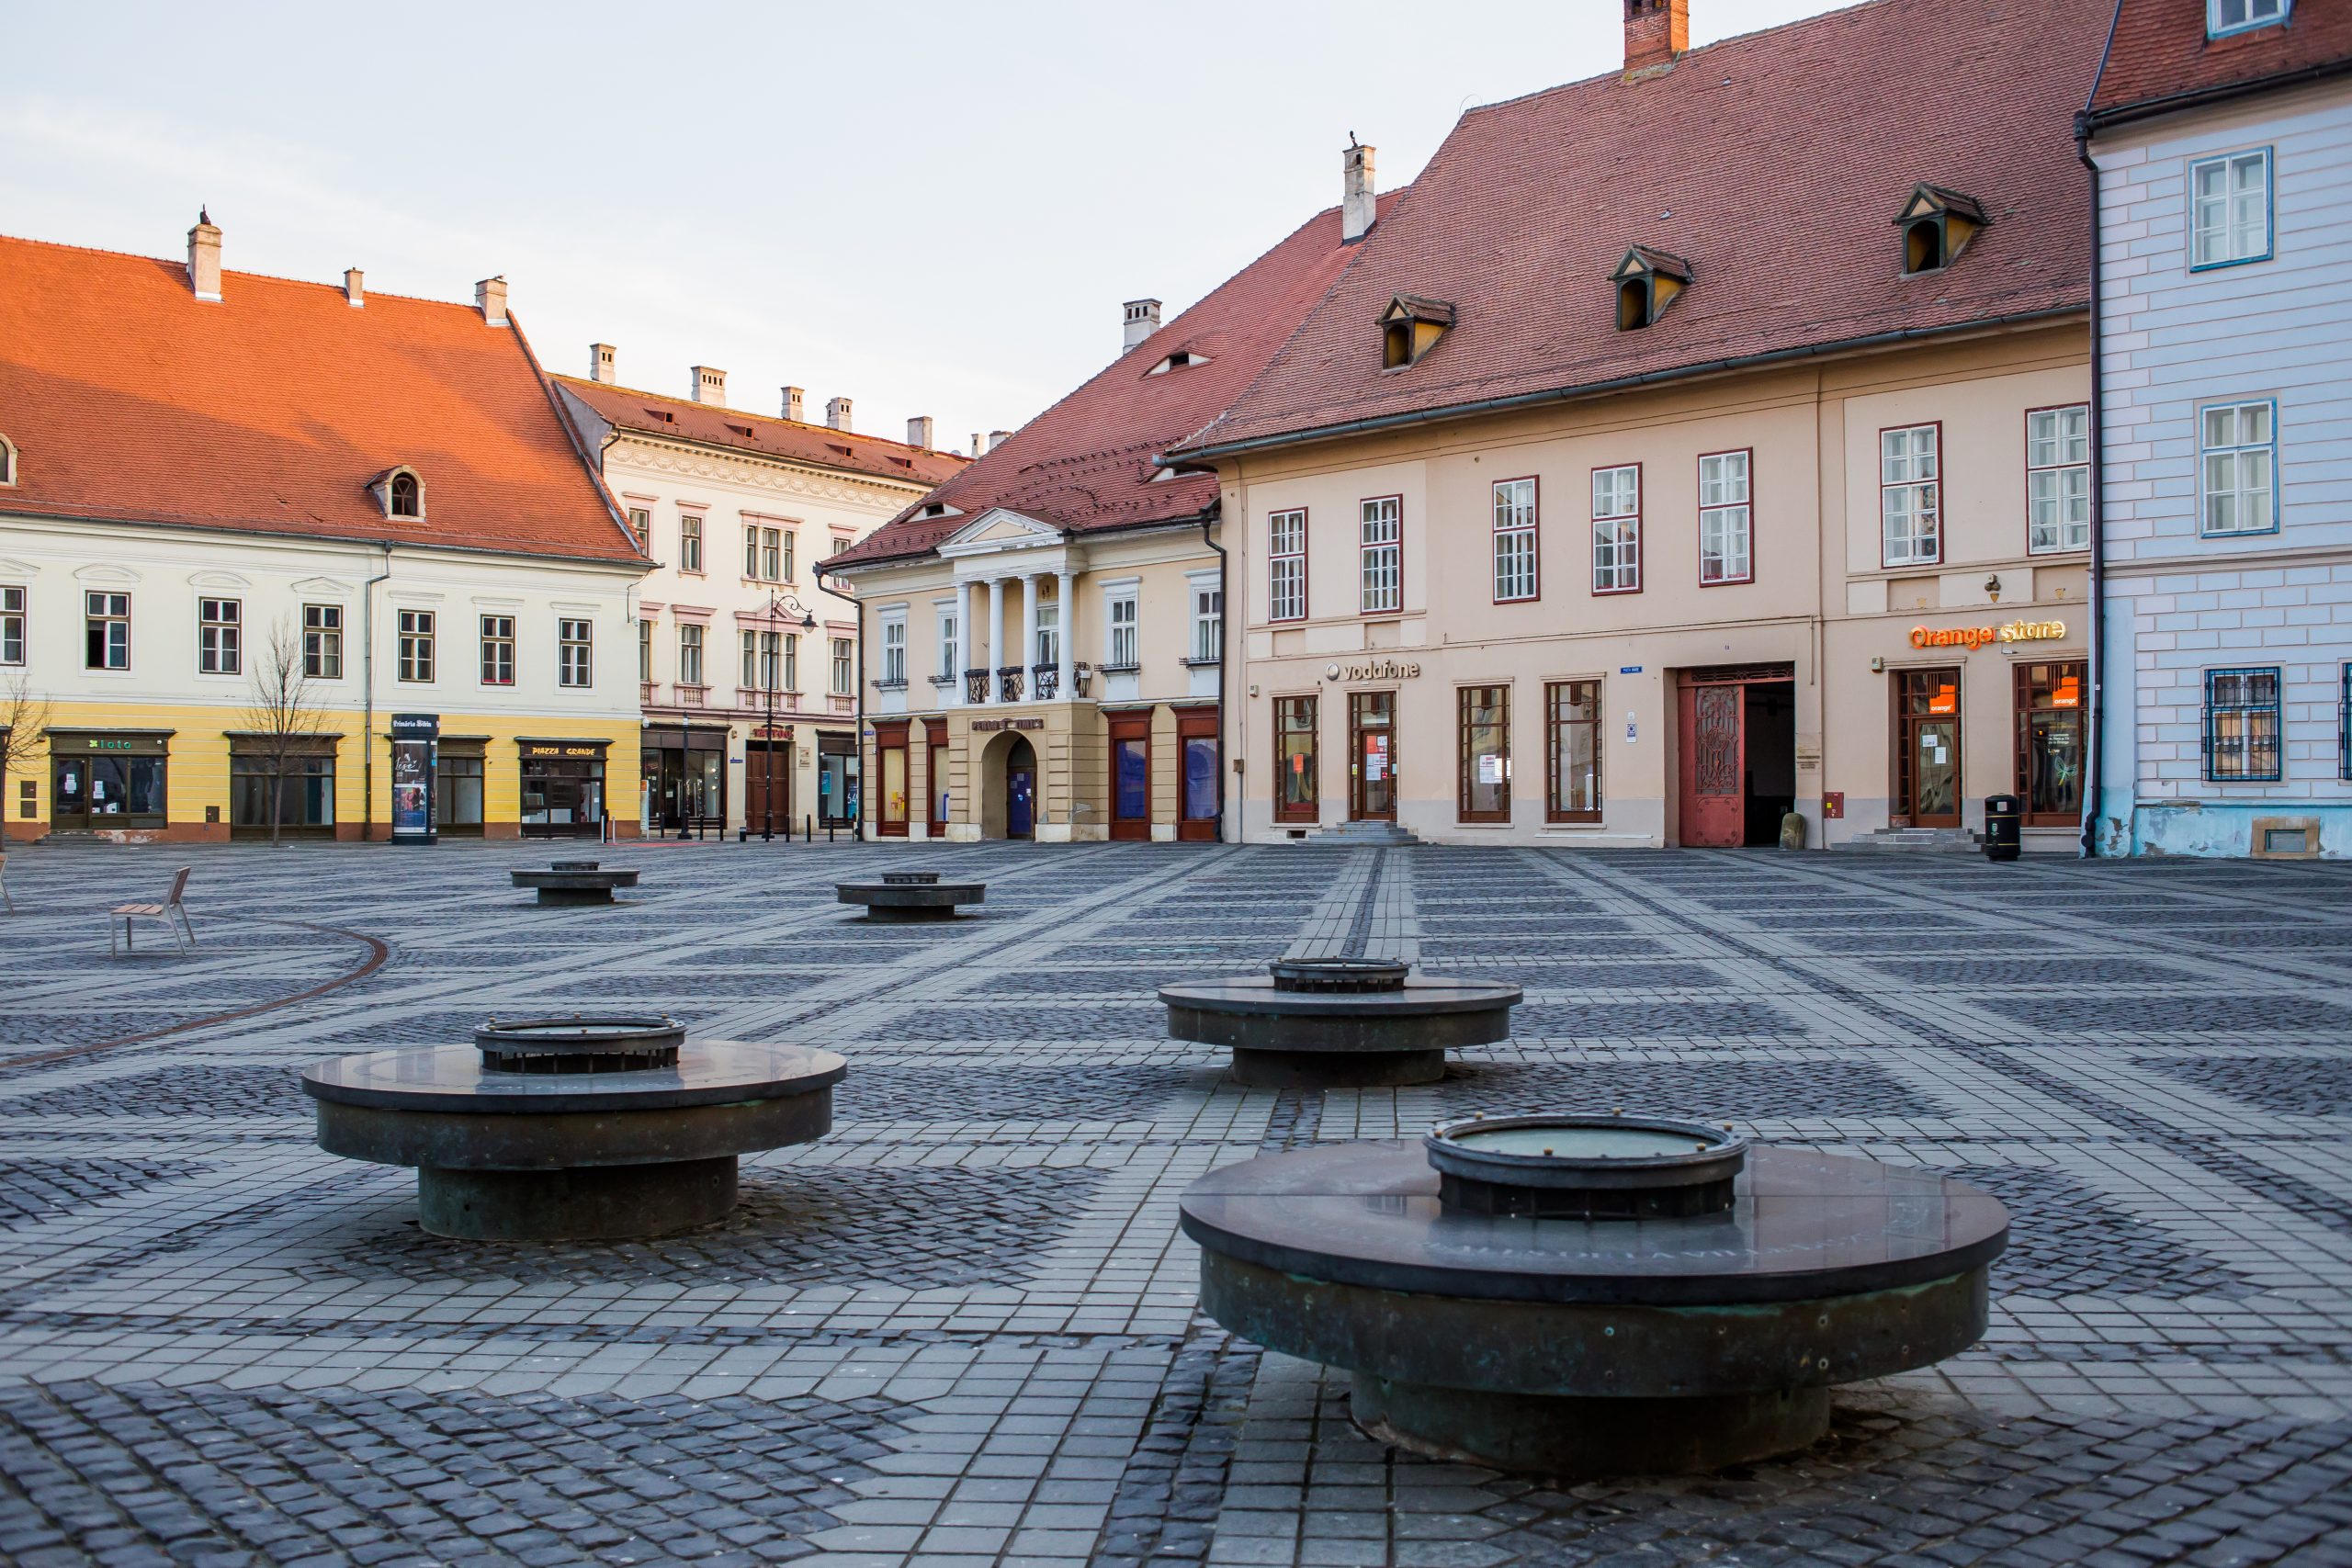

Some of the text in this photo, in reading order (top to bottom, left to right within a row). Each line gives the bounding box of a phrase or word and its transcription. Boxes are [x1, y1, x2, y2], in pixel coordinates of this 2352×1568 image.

[1911, 619, 2066, 649] Orange store
[1345, 660, 1420, 681] vodafone
[2053, 697, 2076, 705] orange
[1930, 705, 1951, 713] orange
[100, 739, 131, 749] loto
[532, 747, 596, 756] PIAZZA GRANDE
